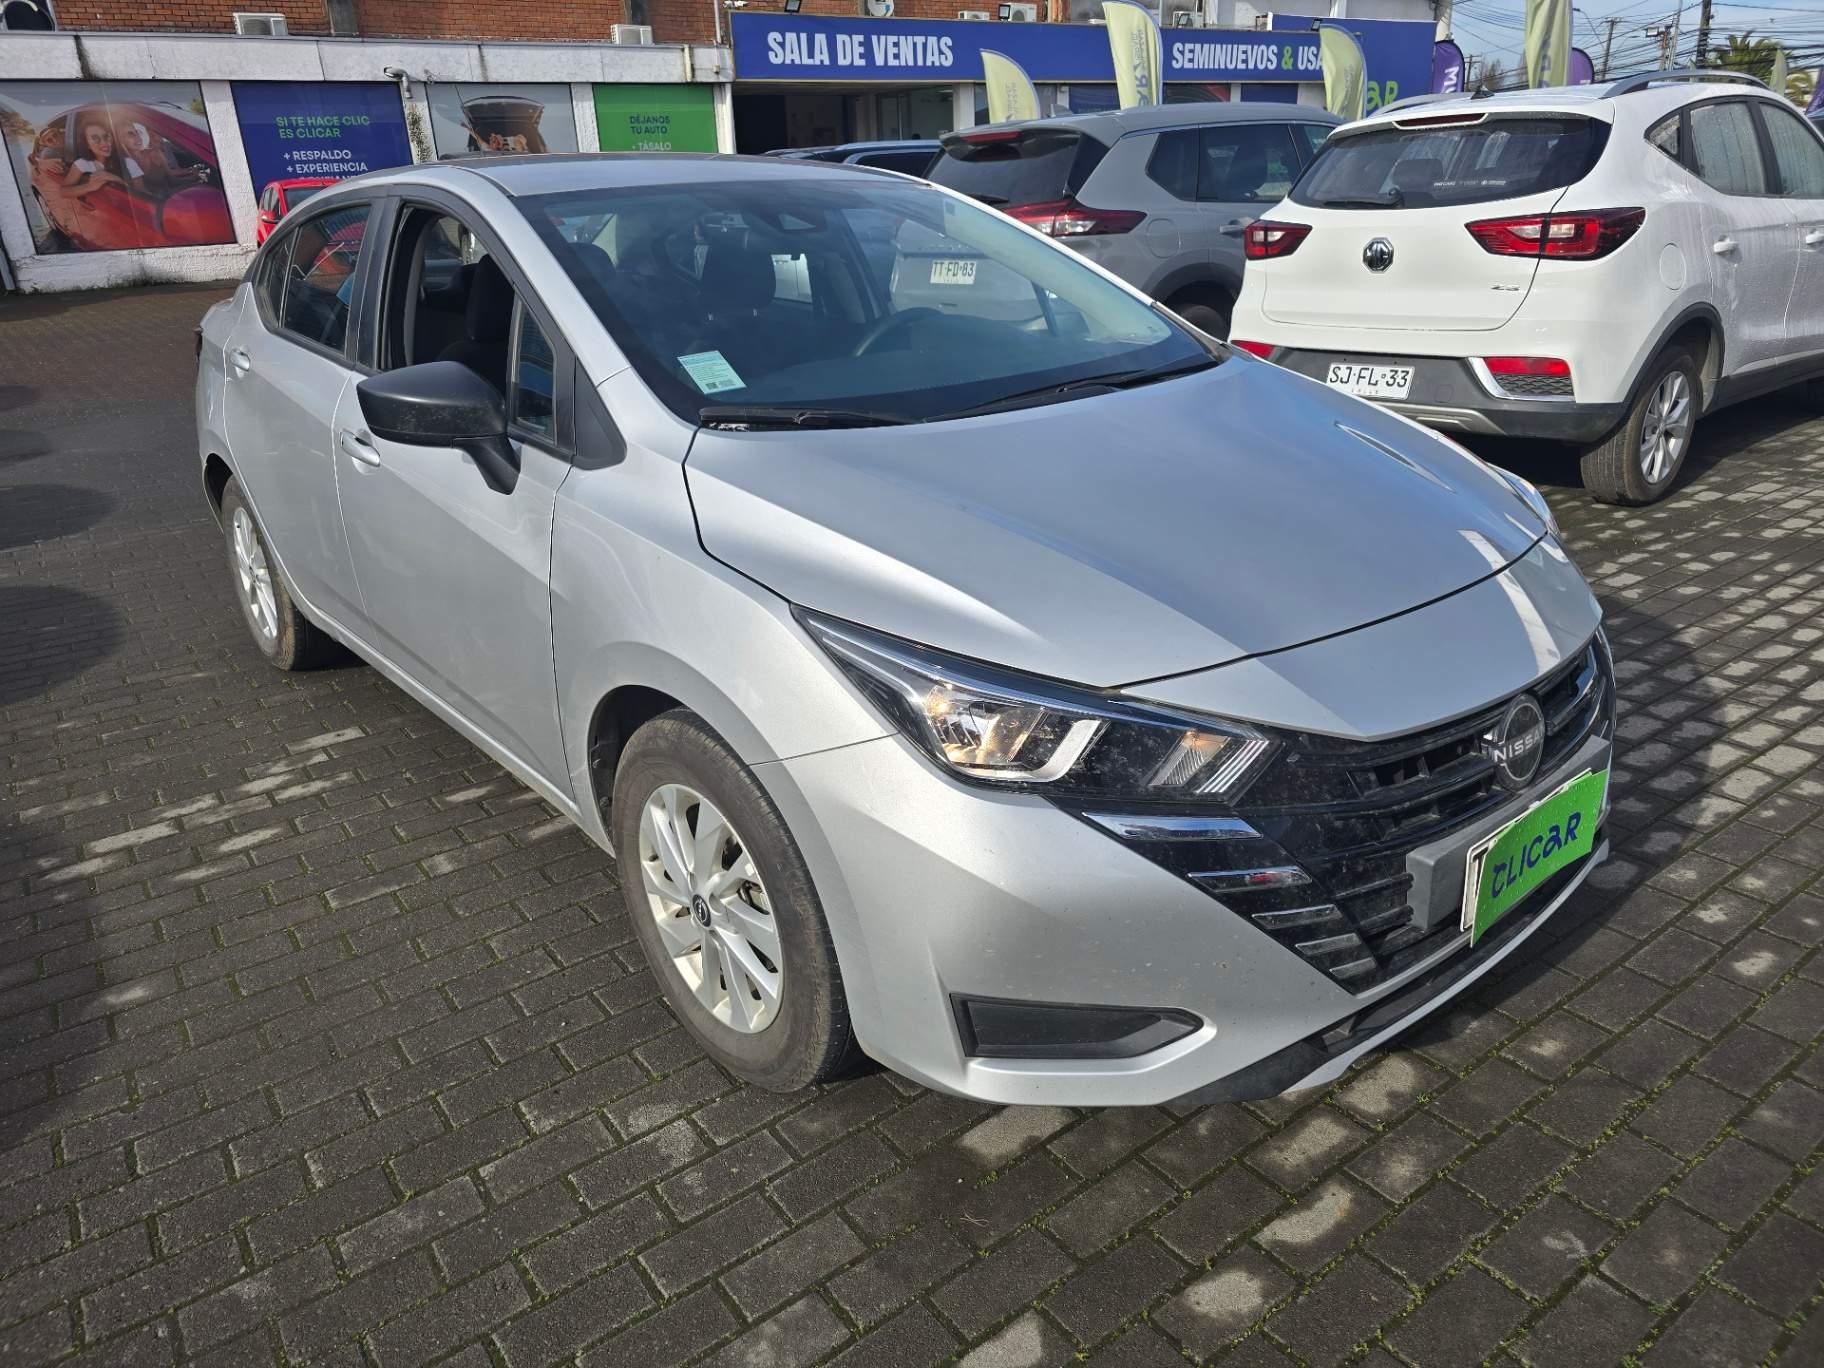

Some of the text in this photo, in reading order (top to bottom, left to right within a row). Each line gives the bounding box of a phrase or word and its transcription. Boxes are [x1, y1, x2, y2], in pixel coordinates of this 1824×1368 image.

[767, 31, 954, 67] SALA DE VENTAS
[1171, 42, 1278, 70] SEMINUEVOS
[1281, 45, 1294, 70] &
[275, 115, 370, 127] SI TE HACE CLIC
[279, 128, 342, 139] ES CLICAR
[630, 126, 668, 135] TU AUTO
[292, 149, 352, 161] RESPALDO
[295, 162, 369, 174] EXPERIENCIA
